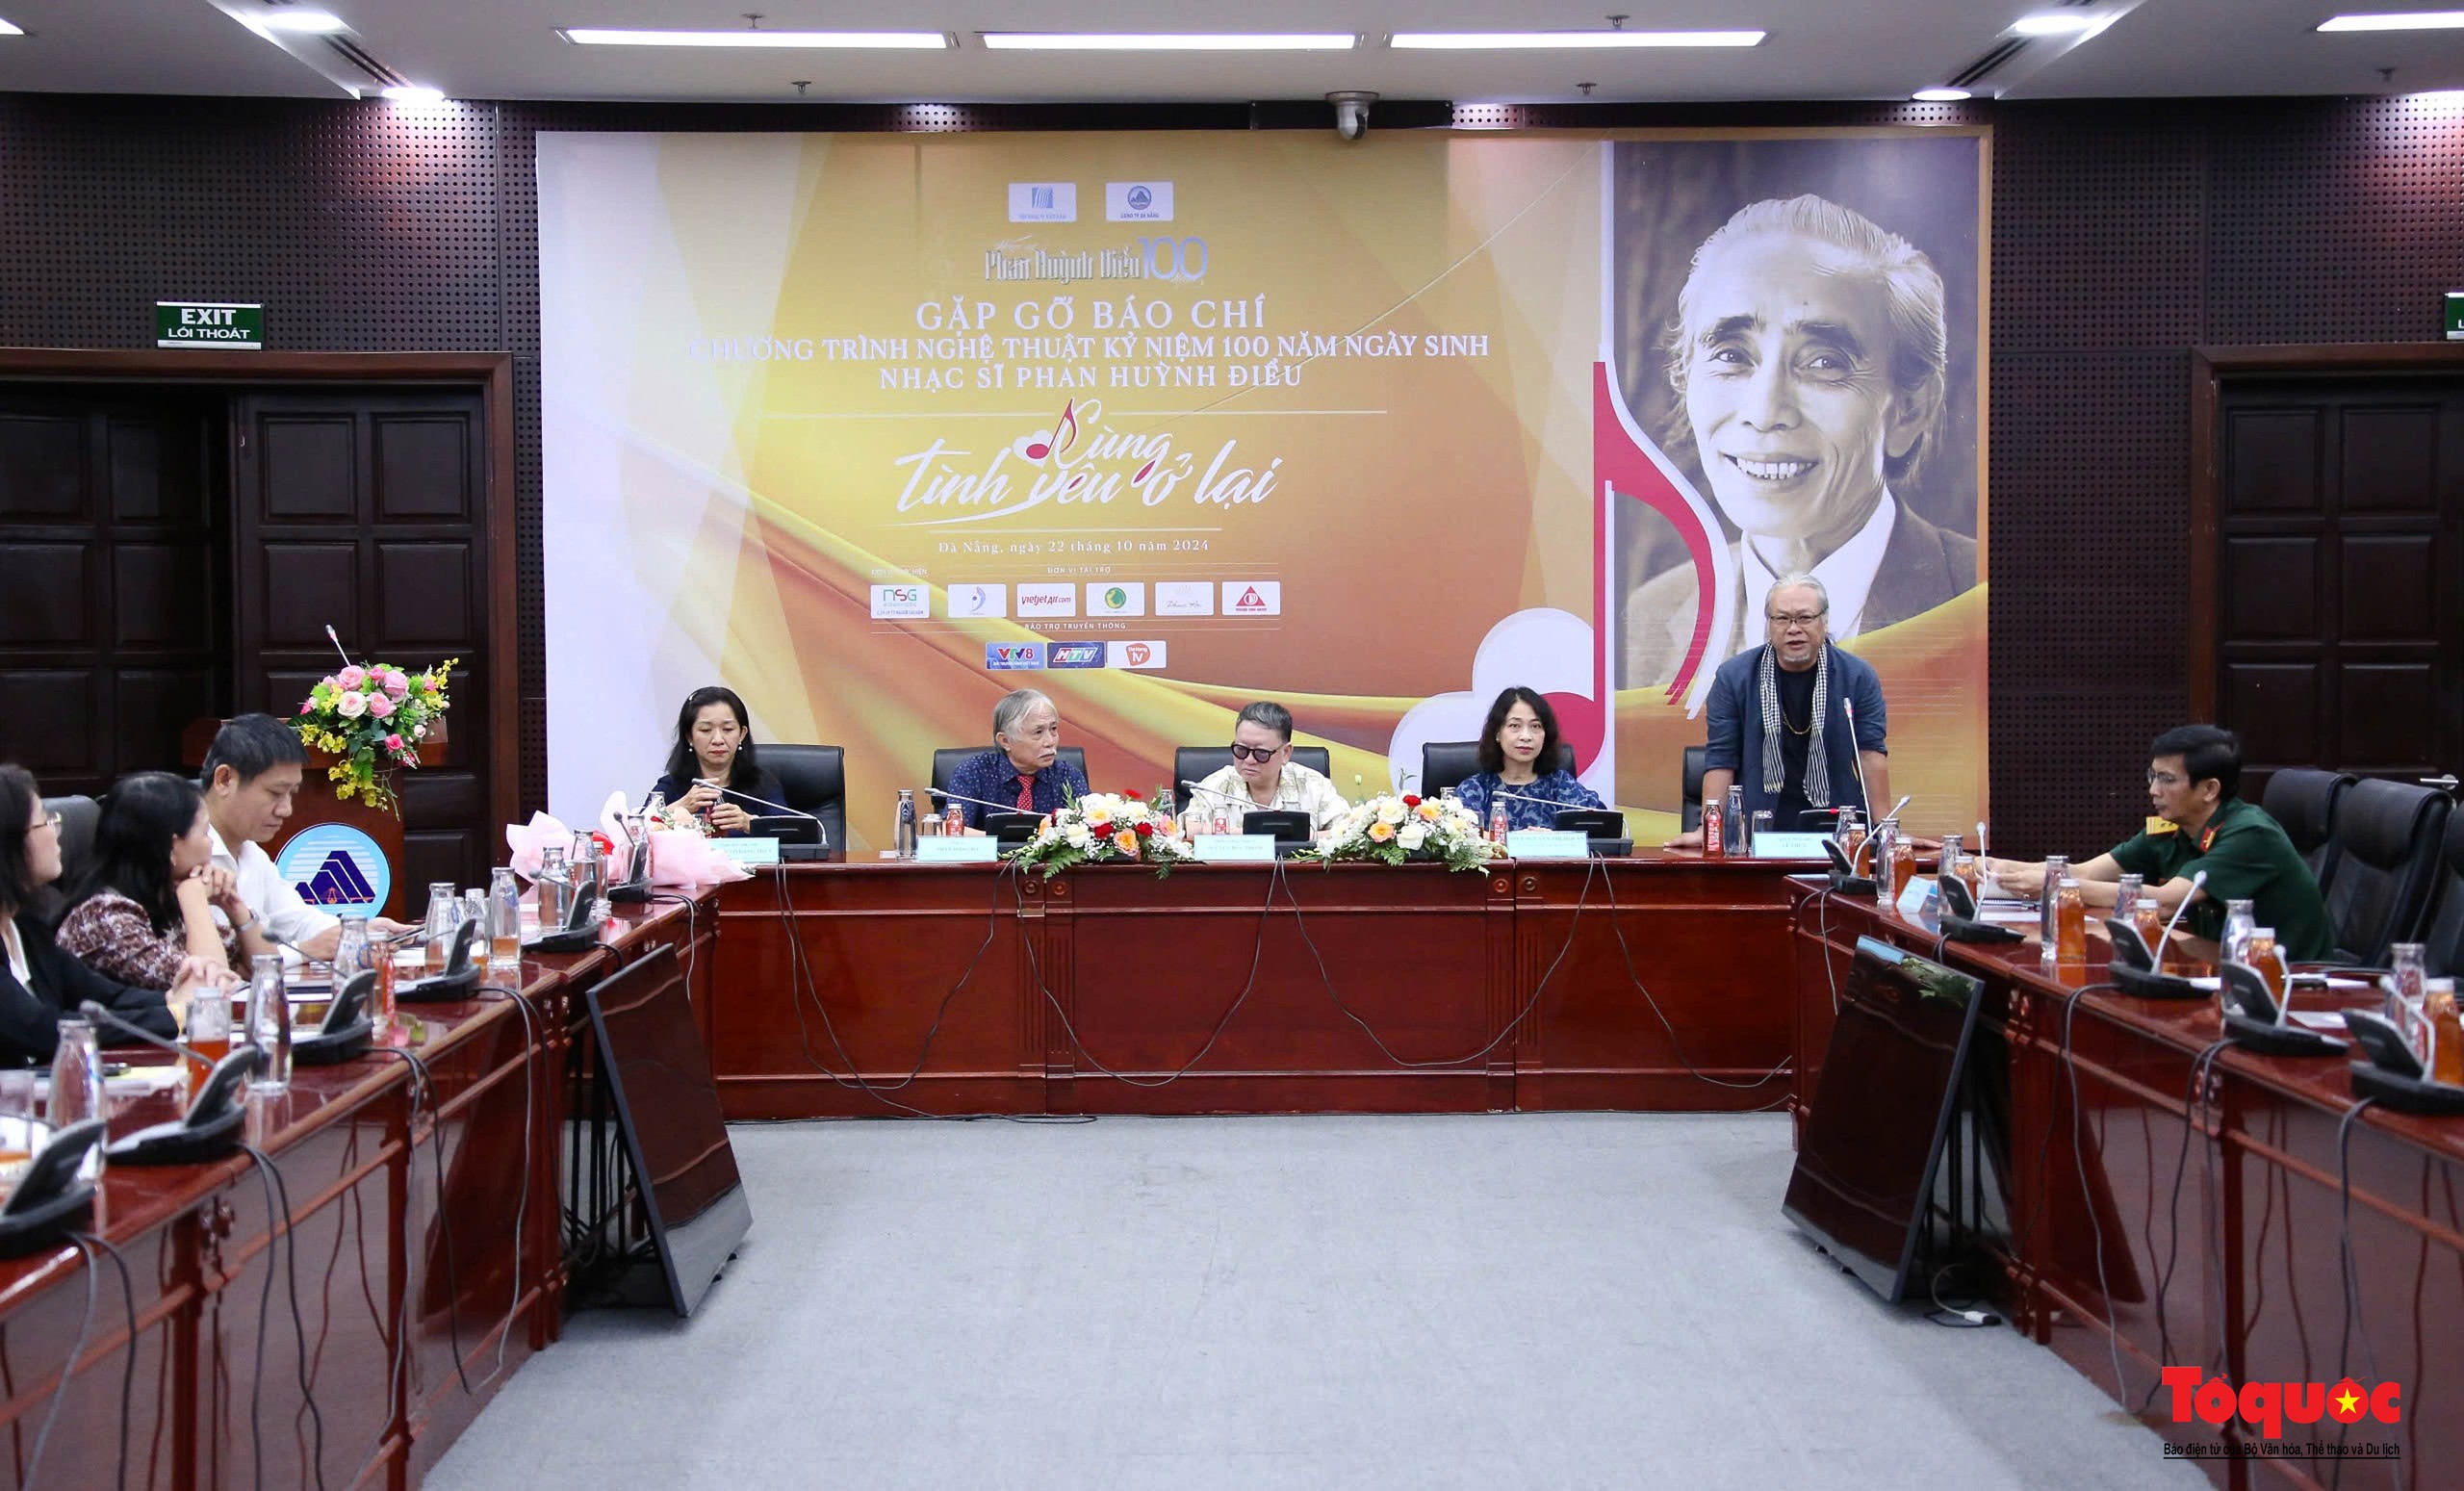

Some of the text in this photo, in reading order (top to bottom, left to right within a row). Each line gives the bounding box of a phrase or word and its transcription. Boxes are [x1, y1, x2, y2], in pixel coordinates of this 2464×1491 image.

[1138, 236, 1208, 280] 100
[181, 308, 237, 325] EXIT
[916, 292, 1267, 336] GẶP GỠ BÁO CHÍ
[167, 326, 250, 339] LỐI THOÁT
[821, 334, 908, 360] TRÌNH
[916, 332, 995, 363] NGHỆ
[1003, 332, 1095, 363] THUẬT
[1104, 331, 1138, 358] KỶ
[1144, 331, 1214, 363] NIỆM
[1222, 336, 1270, 358] 100
[1277, 330, 1337, 358] NĂM
[1344, 330, 1418, 357] NGÀY
[1424, 335, 1490, 357] SINH
[879, 357, 1303, 393] NHẠC SĨ PHAN HUỲNH ĐIỂU
[1194, 439, 1284, 511] lại
[938, 540, 957, 553] Đà
[1010, 540, 1040, 554] ngày
[1048, 540, 1065, 553] 22
[1070, 539, 1111, 554] tháng
[1117, 540, 1132, 552] 10
[1139, 539, 1167, 552] năm
[1172, 539, 1209, 552] 2024
[1055, 648, 1096, 662] HTV
